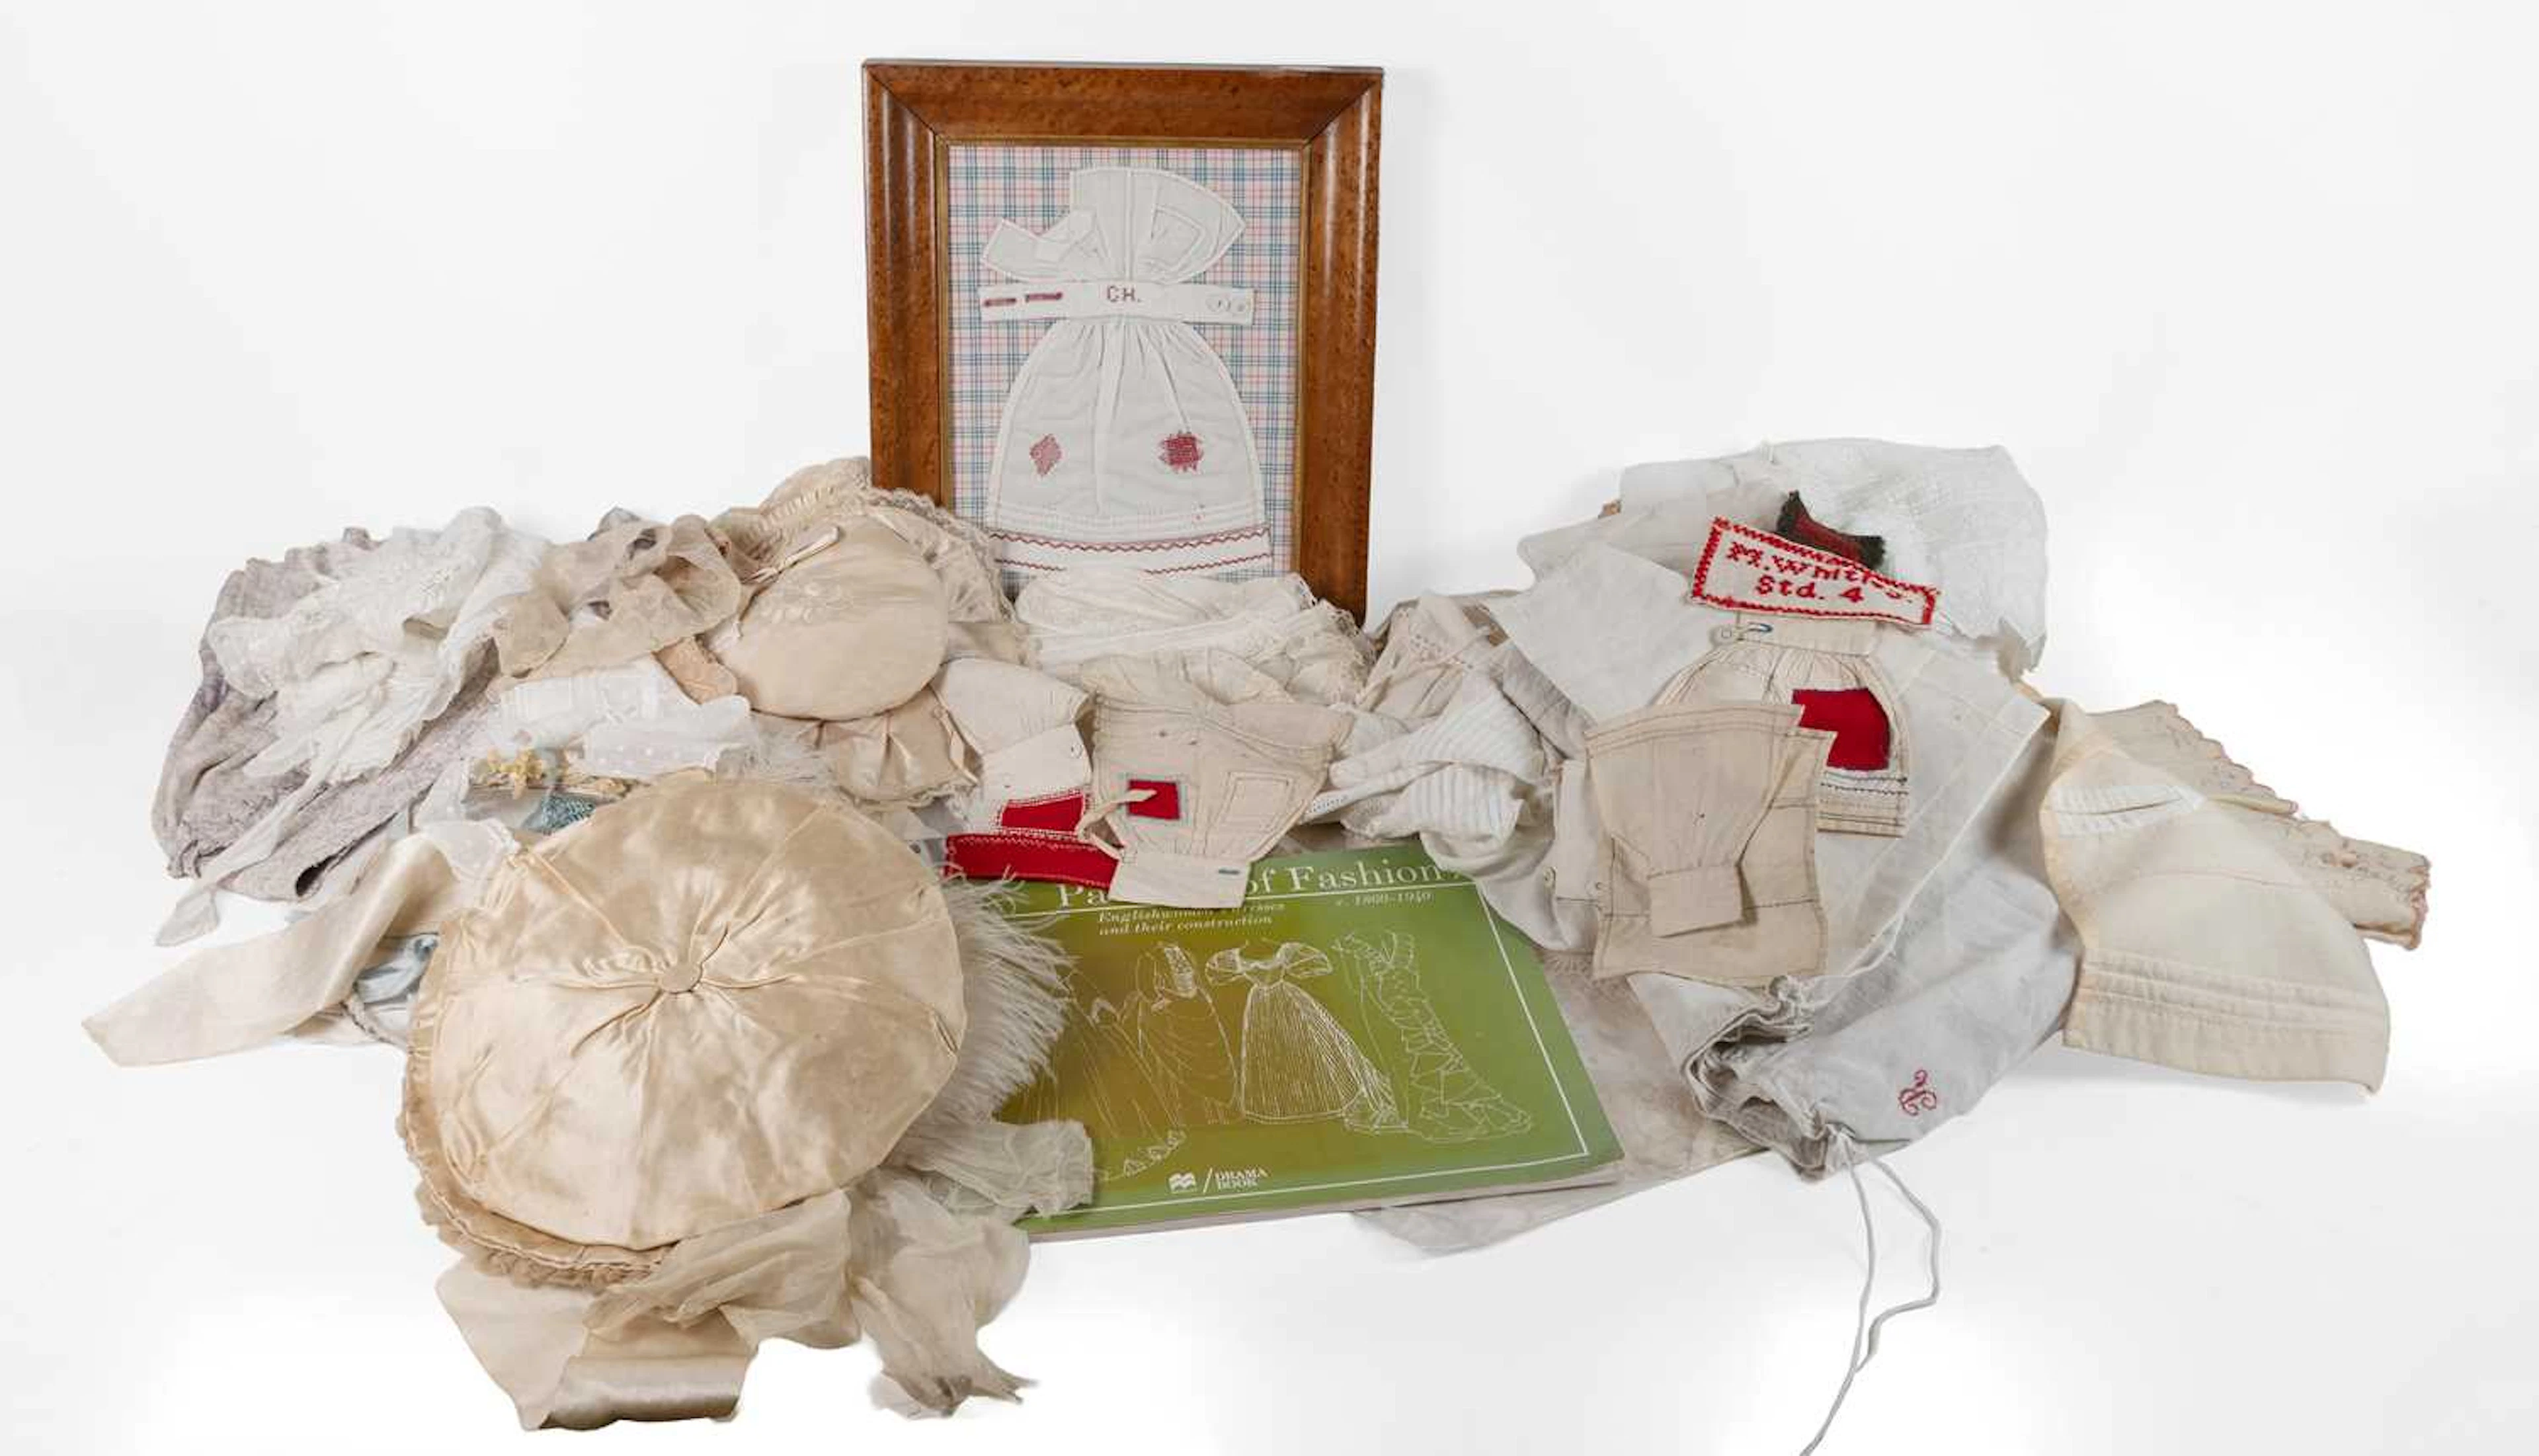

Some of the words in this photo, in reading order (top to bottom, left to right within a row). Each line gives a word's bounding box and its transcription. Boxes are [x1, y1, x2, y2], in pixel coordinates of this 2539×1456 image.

[1756, 575, 1826, 600] Std.
[1837, 585, 1864, 603] 4
[1285, 858, 1446, 892] Fashion
[1099, 922, 1129, 936] and
[1134, 920, 1171, 934] their
[1177, 915, 1273, 932] construction
